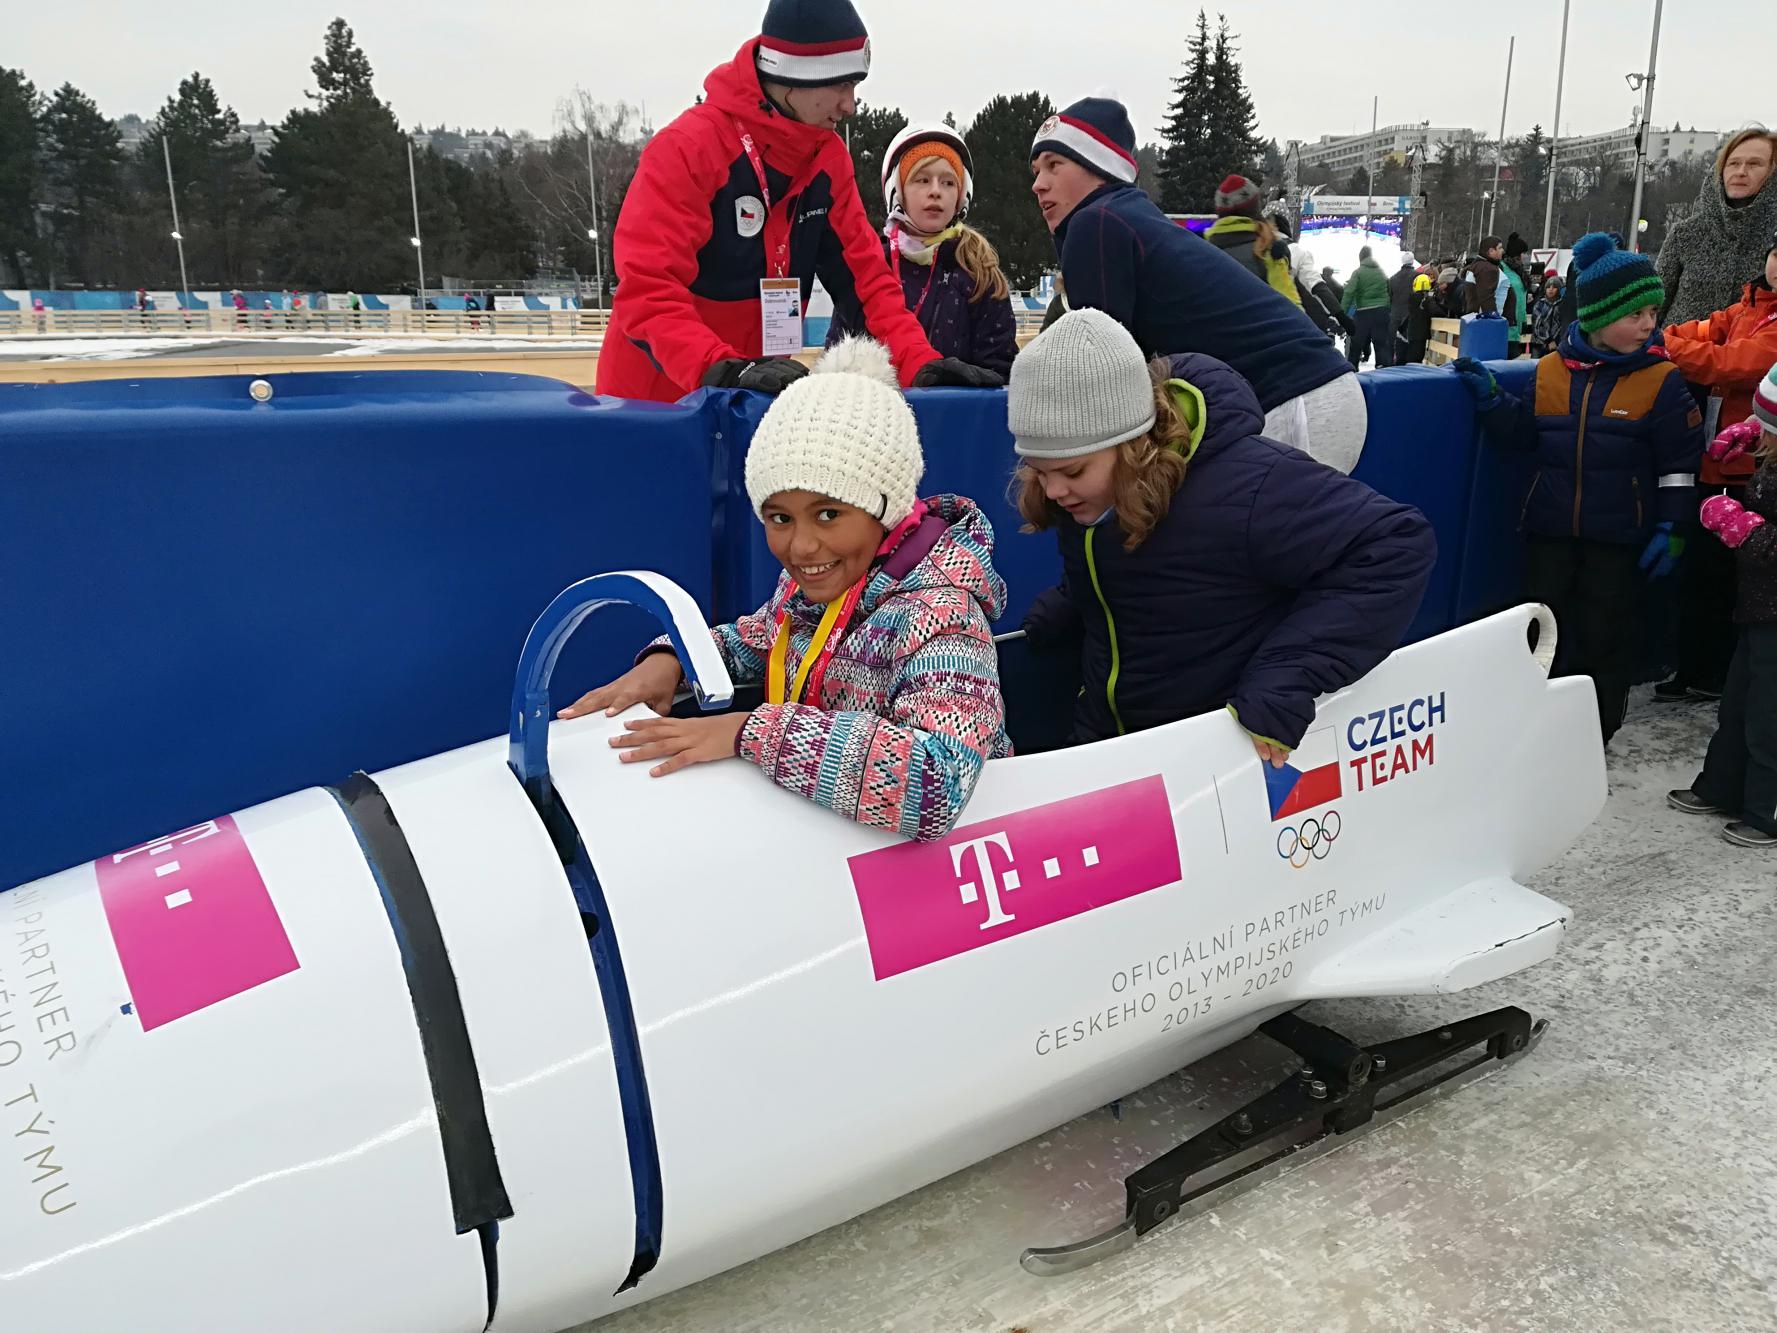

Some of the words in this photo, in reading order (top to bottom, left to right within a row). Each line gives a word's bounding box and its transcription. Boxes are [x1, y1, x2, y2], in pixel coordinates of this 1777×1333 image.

[1347, 691, 1446, 752] CZECH
[1350, 733, 1434, 792] TEAM
[16, 911, 77, 1061] PARTNER
[1036, 992, 1156, 1056] ČESKEHO
[1169, 918, 1329, 1002] OLYMPIJSKÉHO
[1338, 893, 1386, 927] TÝMU
[1112, 924, 1234, 993] OFICIÁLNÍ
[1245, 889, 1337, 942] PARTNER
[1161, 996, 1214, 1033] 2013
[1242, 960, 1293, 998] 2020
[5, 1083, 77, 1215] TÝMU
